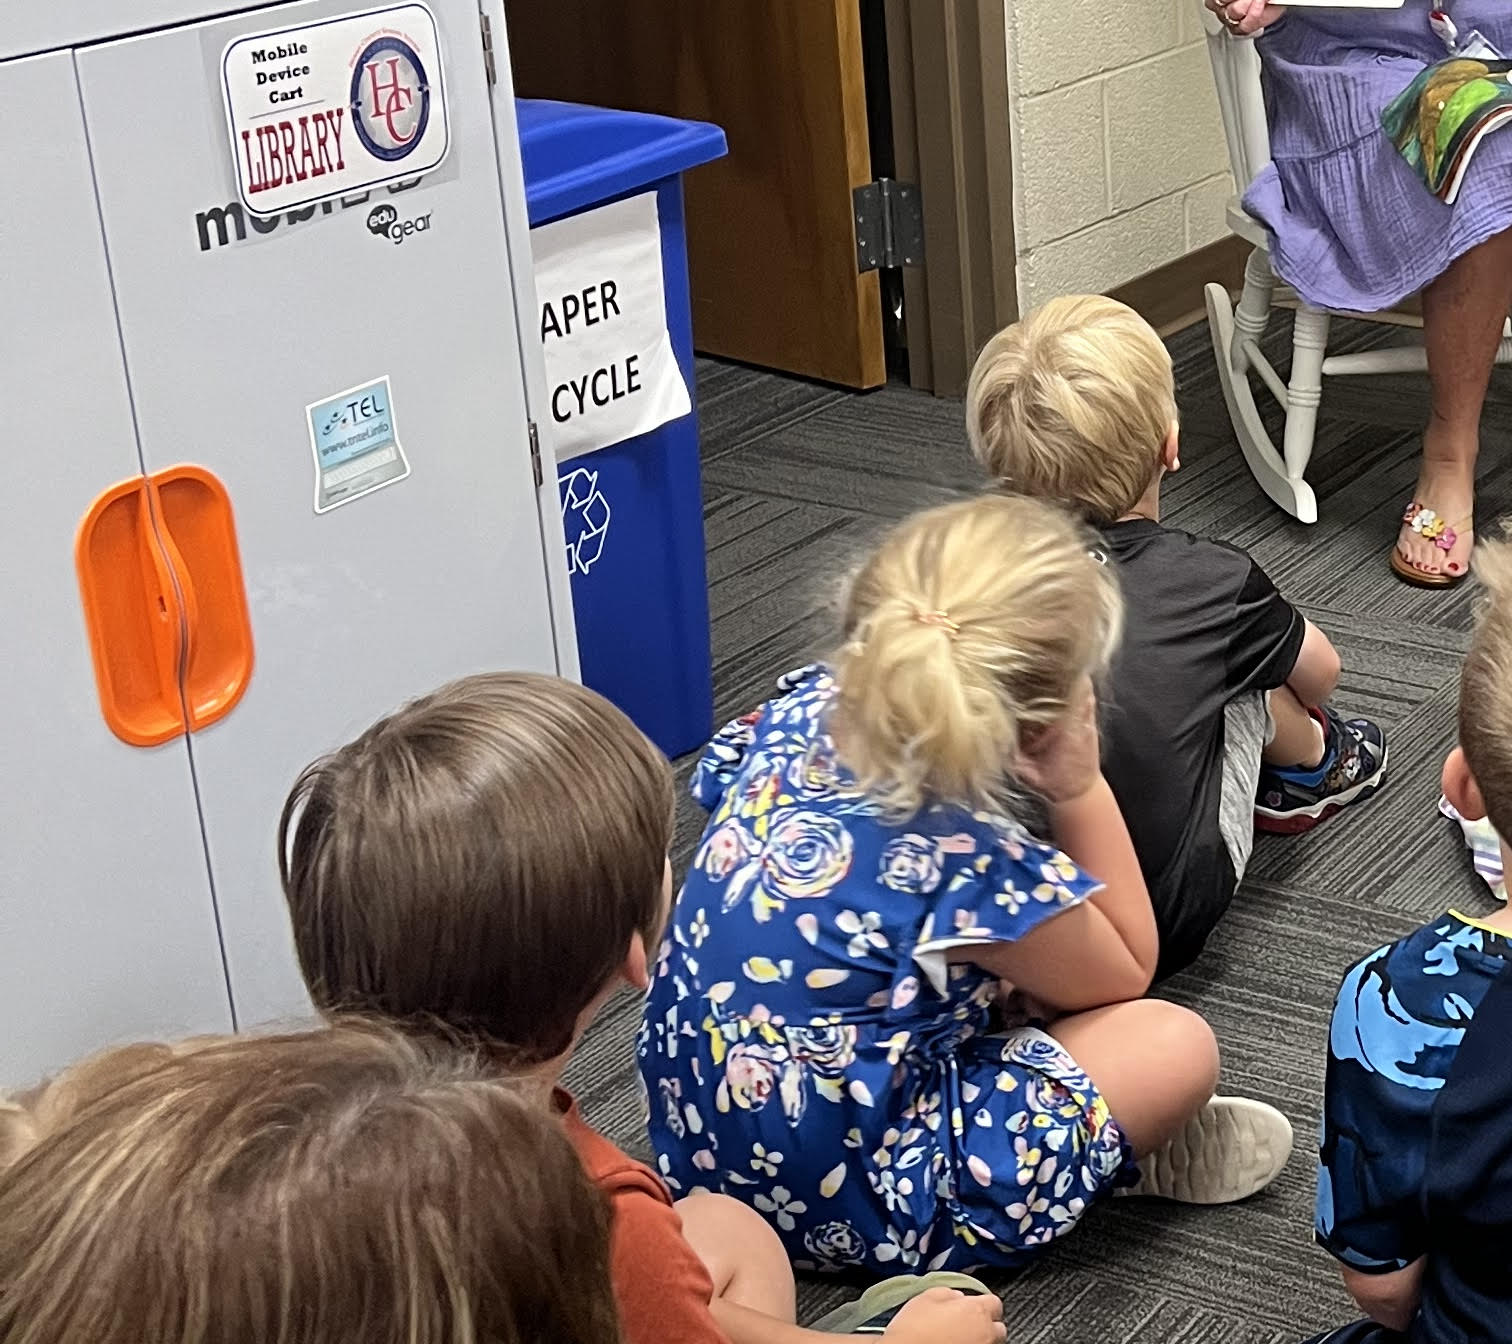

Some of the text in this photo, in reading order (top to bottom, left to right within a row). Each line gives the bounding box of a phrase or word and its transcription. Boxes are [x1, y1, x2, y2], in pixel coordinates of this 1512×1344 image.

[251, 43, 308, 64] Mobile
[256, 63, 310, 85] Device
[269, 86, 304, 105] Cart
[241, 107, 345, 194] LIBRARY
[368, 207, 397, 227] edu
[391, 213, 432, 245] gear
[541, 279, 621, 344] APER
[551, 355, 642, 424] CYCLE
